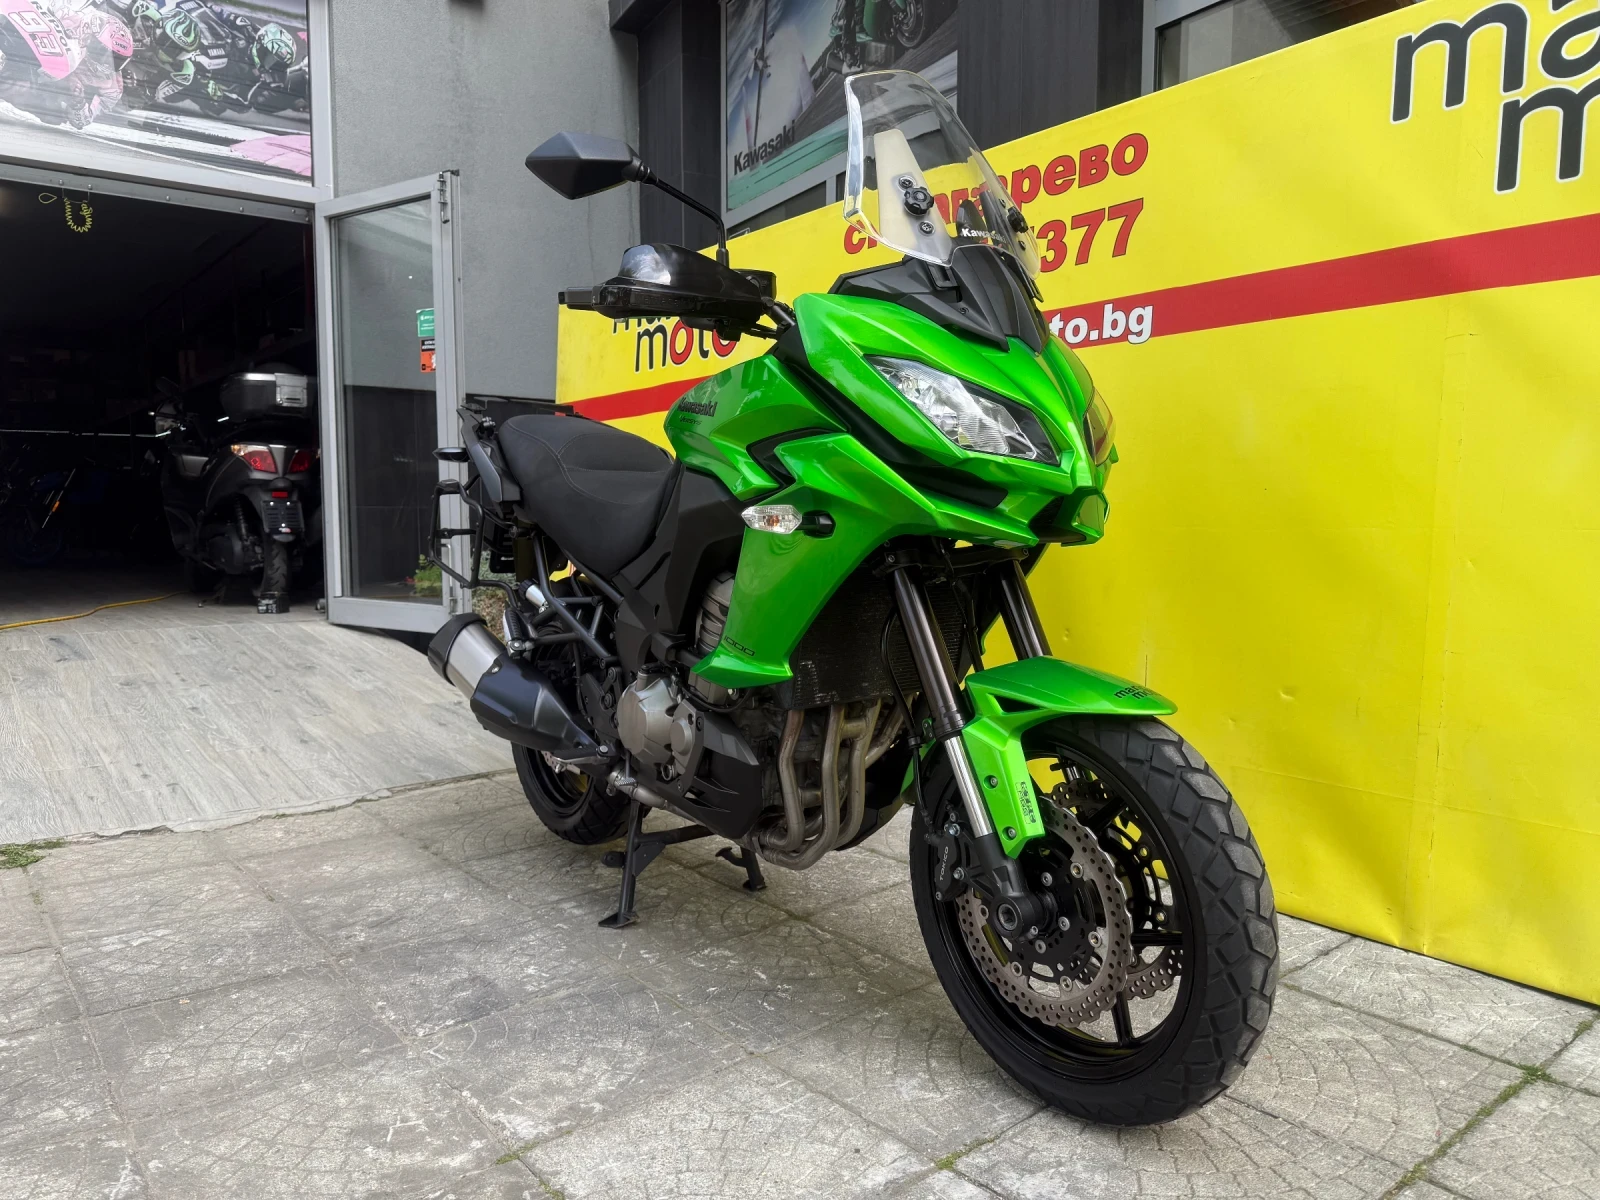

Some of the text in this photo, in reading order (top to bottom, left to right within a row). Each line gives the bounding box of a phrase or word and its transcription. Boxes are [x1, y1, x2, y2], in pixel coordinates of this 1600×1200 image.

[733, 119, 796, 176] Kawasaki
[678, 397, 718, 417] Kawasaki
[723, 636, 755, 657] 1000
[939, 845, 949, 882] TOKICO
